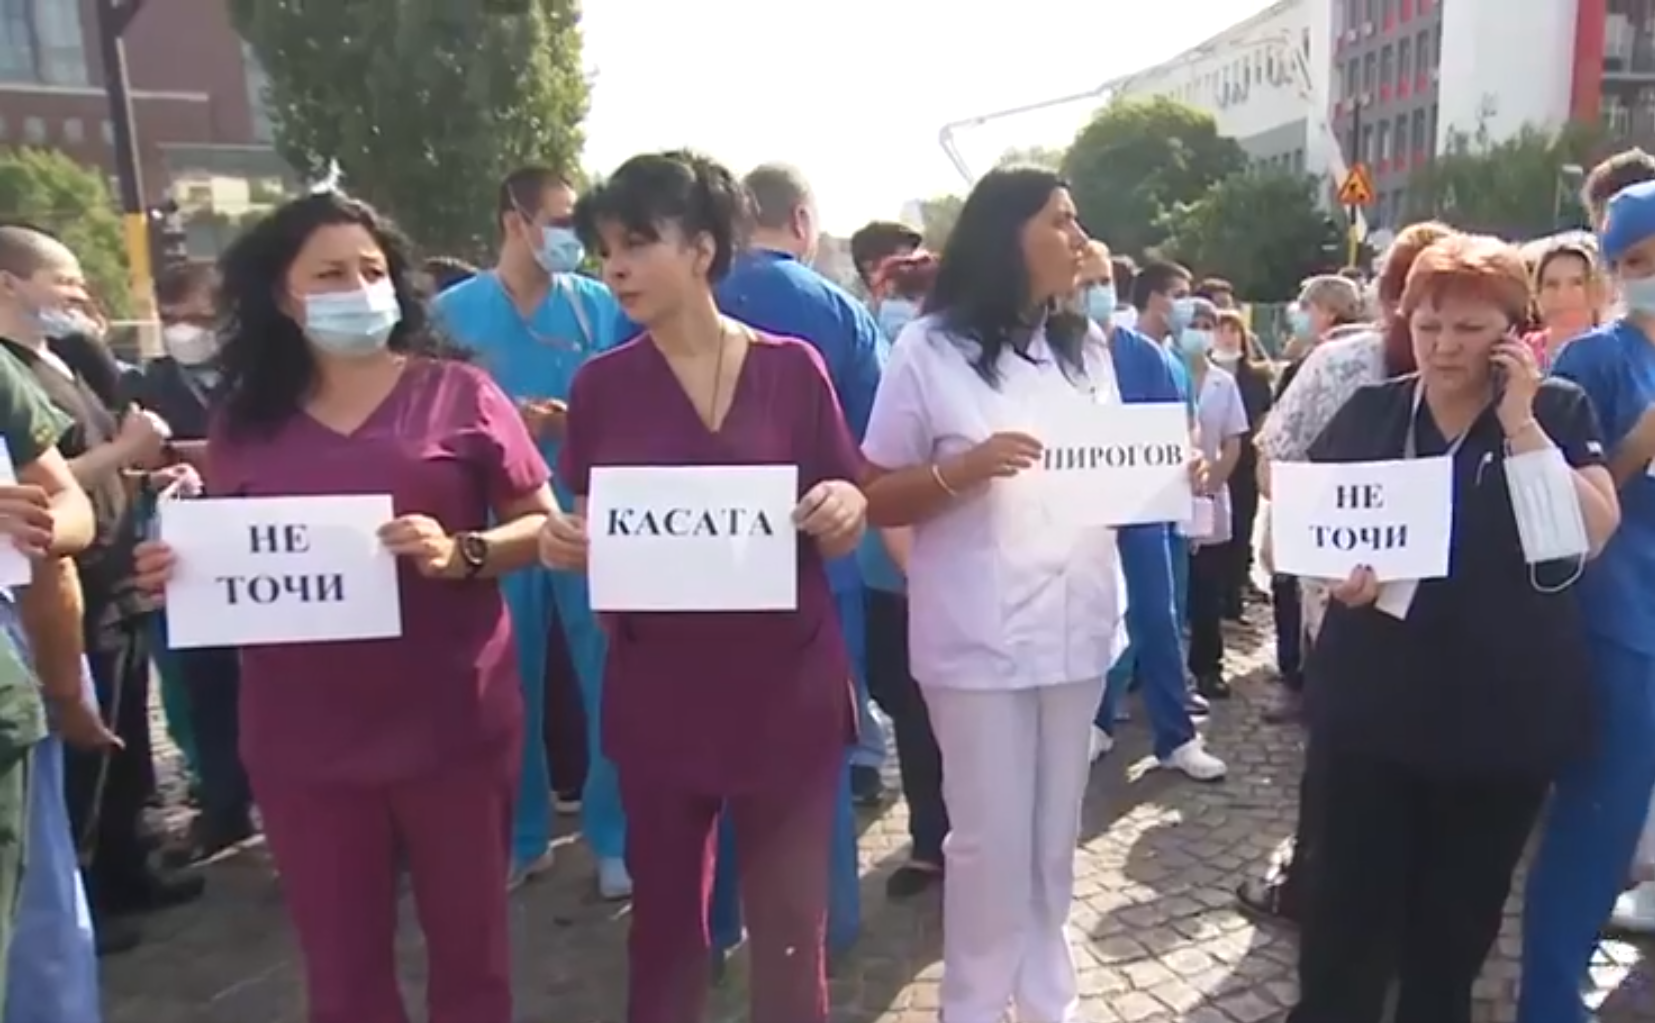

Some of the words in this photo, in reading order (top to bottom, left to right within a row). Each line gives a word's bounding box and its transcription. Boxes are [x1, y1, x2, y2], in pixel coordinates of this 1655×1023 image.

[1043, 443, 1183, 471] ПИРОГОВ
[1336, 483, 1384, 509] НЕ
[606, 507, 773, 536] КАСАТА
[248, 524, 311, 553] НЕ
[1308, 524, 1407, 551] ТОЧИ
[214, 572, 345, 605] ТОЧИ
